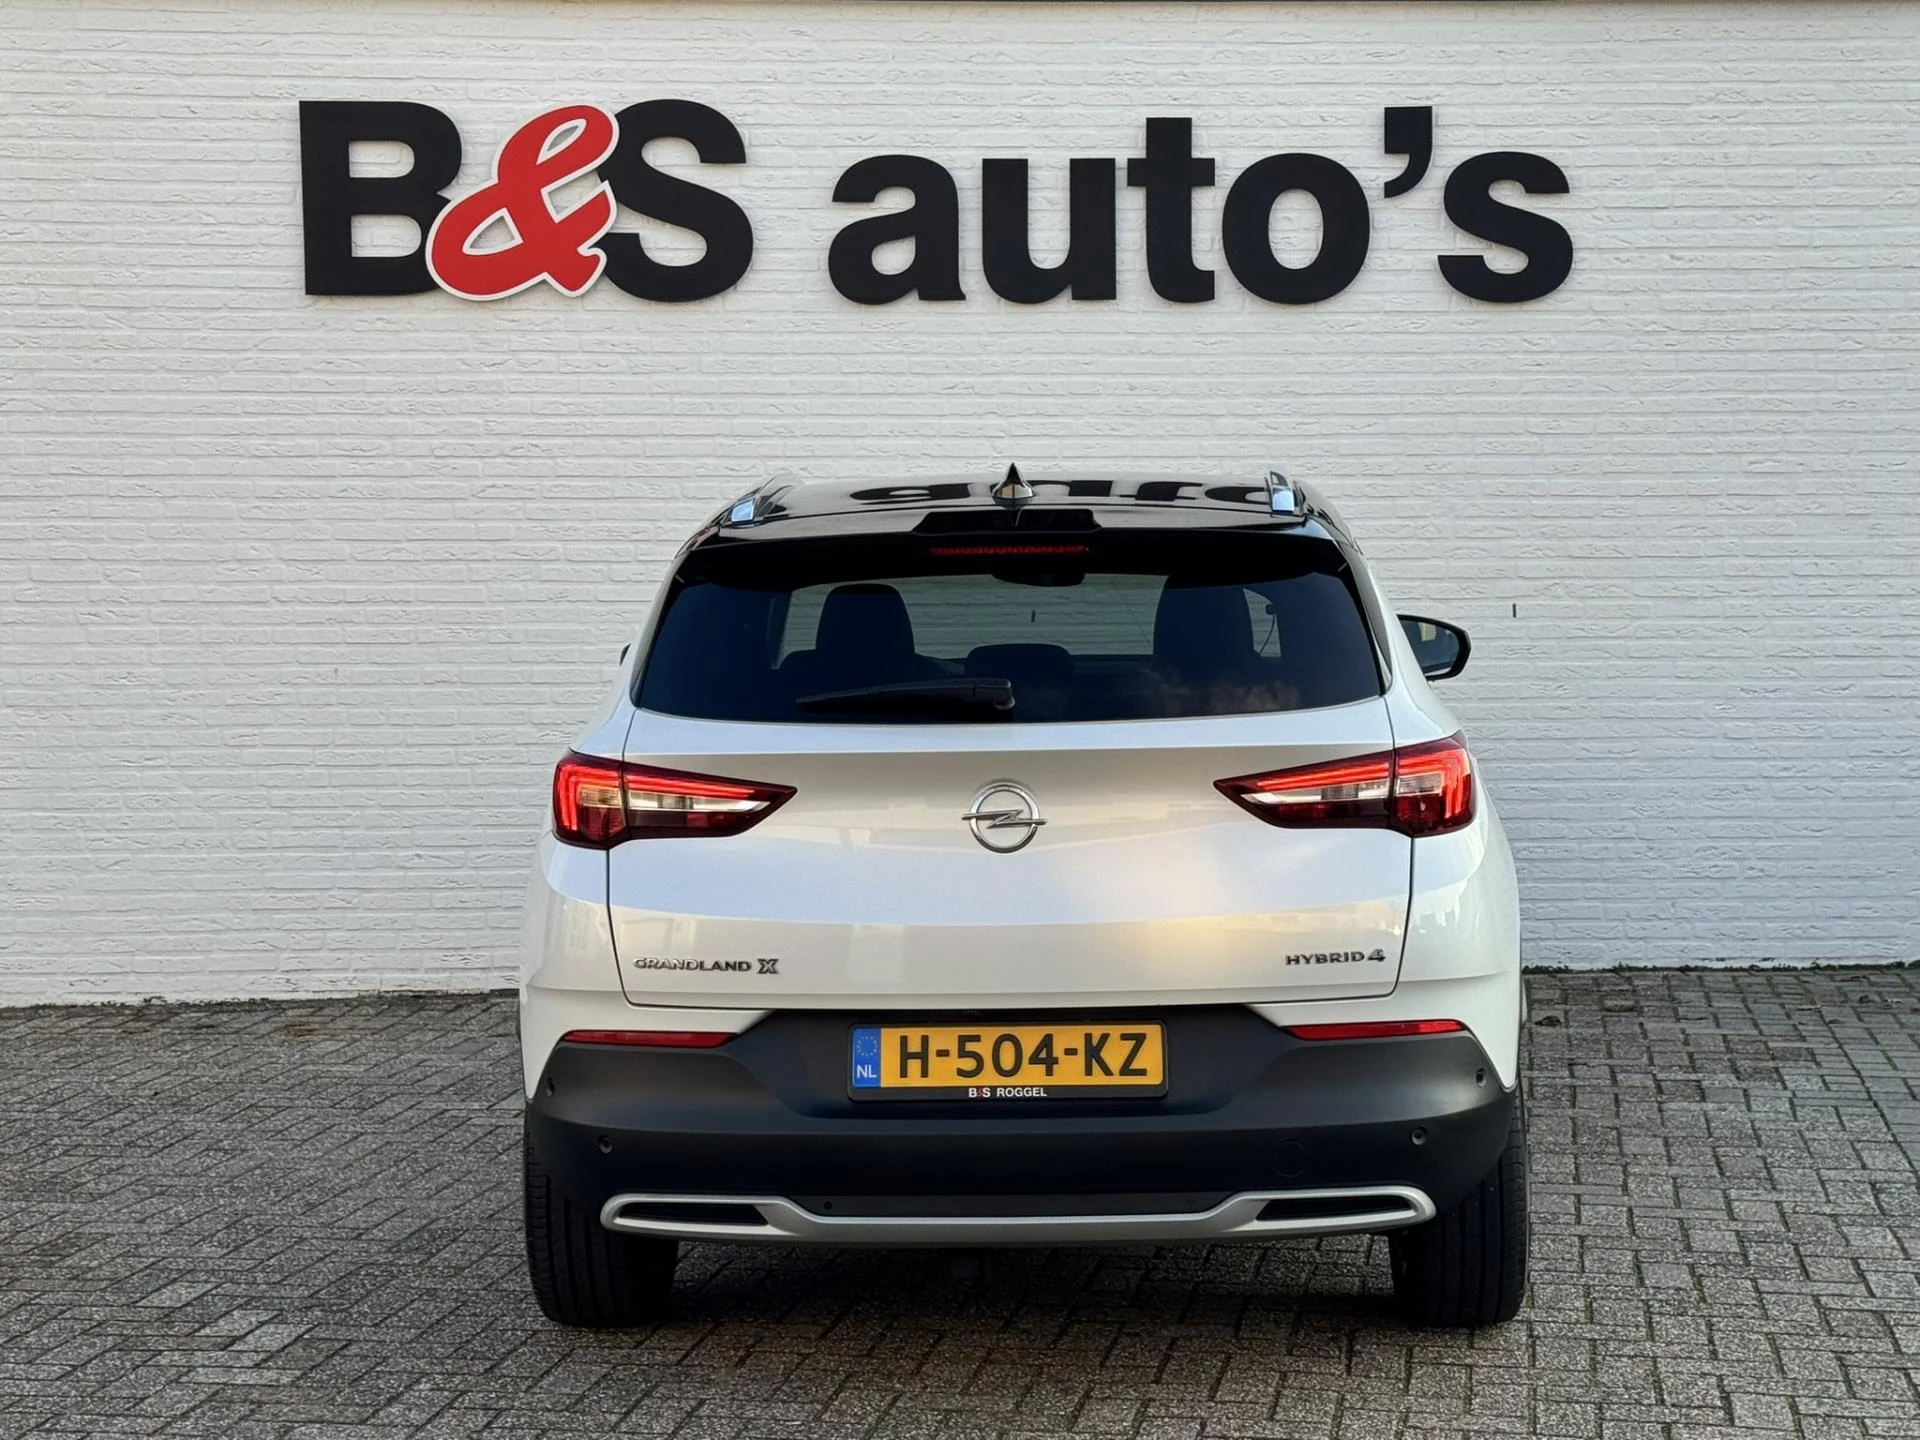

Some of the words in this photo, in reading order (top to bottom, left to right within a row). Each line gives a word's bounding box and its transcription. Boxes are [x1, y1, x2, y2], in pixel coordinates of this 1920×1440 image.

[299, 99, 754, 302] B&S
[828, 105, 1574, 305] auto's
[633, 957, 752, 972] GRANDLAND
[756, 958, 780, 975] X
[899, 1032, 1148, 1079] H-504-KZ
[856, 1064, 877, 1078] NL
[996, 1087, 1048, 1098] ROGGEL
